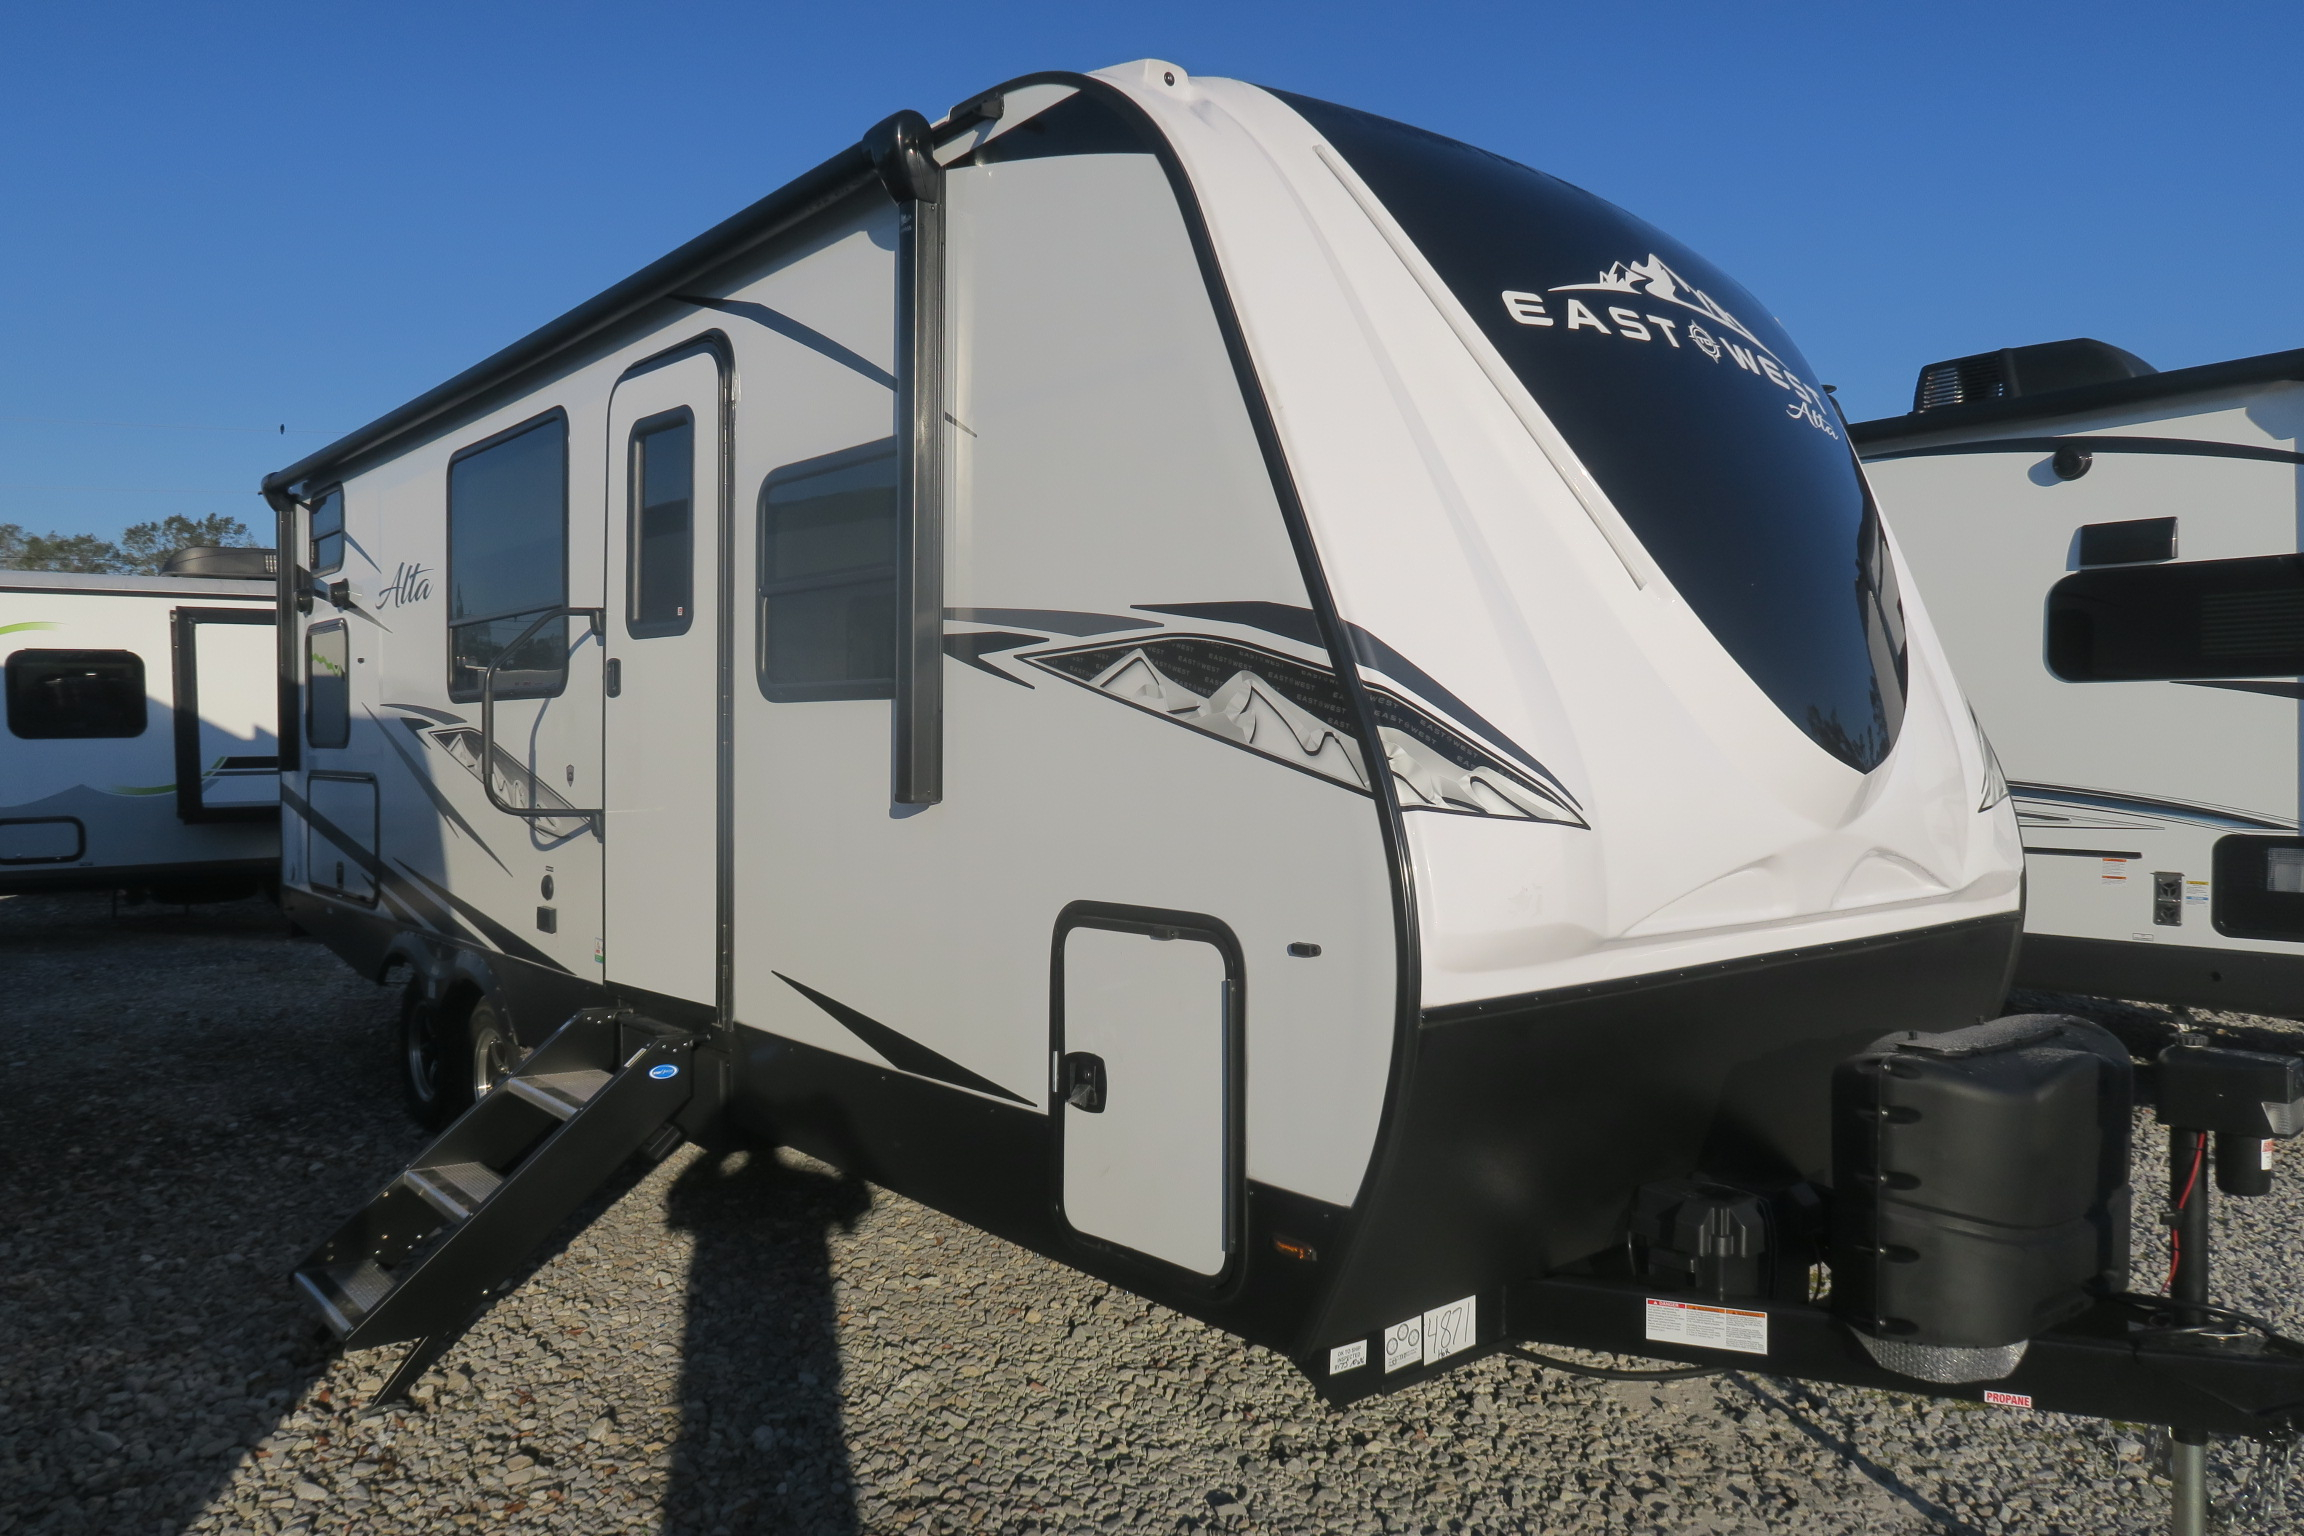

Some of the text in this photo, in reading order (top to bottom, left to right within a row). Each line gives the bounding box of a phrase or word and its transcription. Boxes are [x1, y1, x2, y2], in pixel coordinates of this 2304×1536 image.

[1502, 290, 1680, 348] EAST
[1719, 337, 1827, 415] WEST
[1786, 402, 1839, 440] Alta
[375, 562, 434, 610] Alta
[1172, 665, 1190, 676] WEST
[1178, 655, 1220, 673] EAST WEST
[1209, 653, 1252, 670] EAST WEST
[1268, 671, 1315, 691] EAST WEST
[1296, 693, 1346, 714] EAST WEST
[1369, 694, 1399, 709] WEST
[1327, 717, 1350, 730] EAST
[1374, 709, 1437, 745] EAST WEST
[1420, 719, 1479, 759] EAST WEST
[1456, 755, 1476, 771] EAS
[1427, 1302, 1470, 1354] 4871
[1337, 1352, 1361, 1363] INSPECTED
[1986, 1391, 2030, 1407] PROPANE
